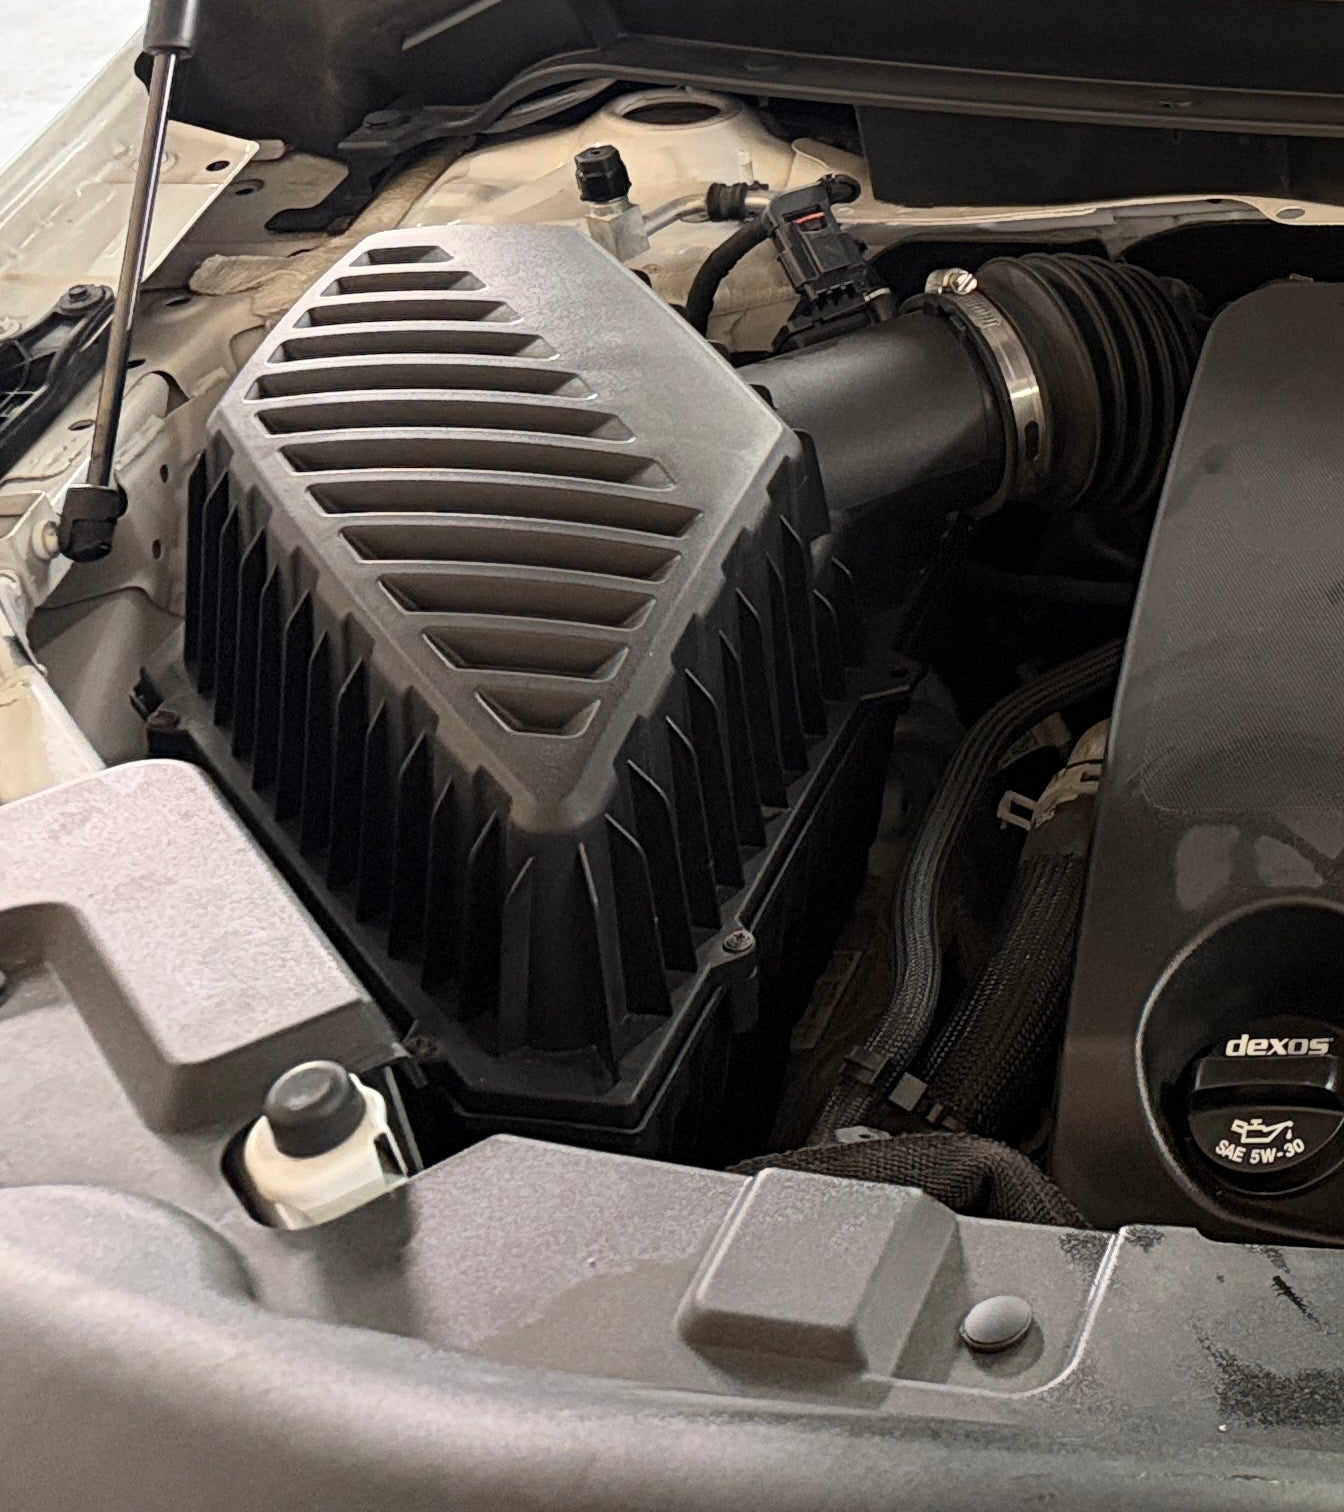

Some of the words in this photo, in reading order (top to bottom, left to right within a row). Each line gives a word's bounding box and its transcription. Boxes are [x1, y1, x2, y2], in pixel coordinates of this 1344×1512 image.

[1224, 1033, 1331, 1057] dexos
[1215, 1139, 1247, 1163] SAE
[1249, 1138, 1306, 1165] 5W-30
